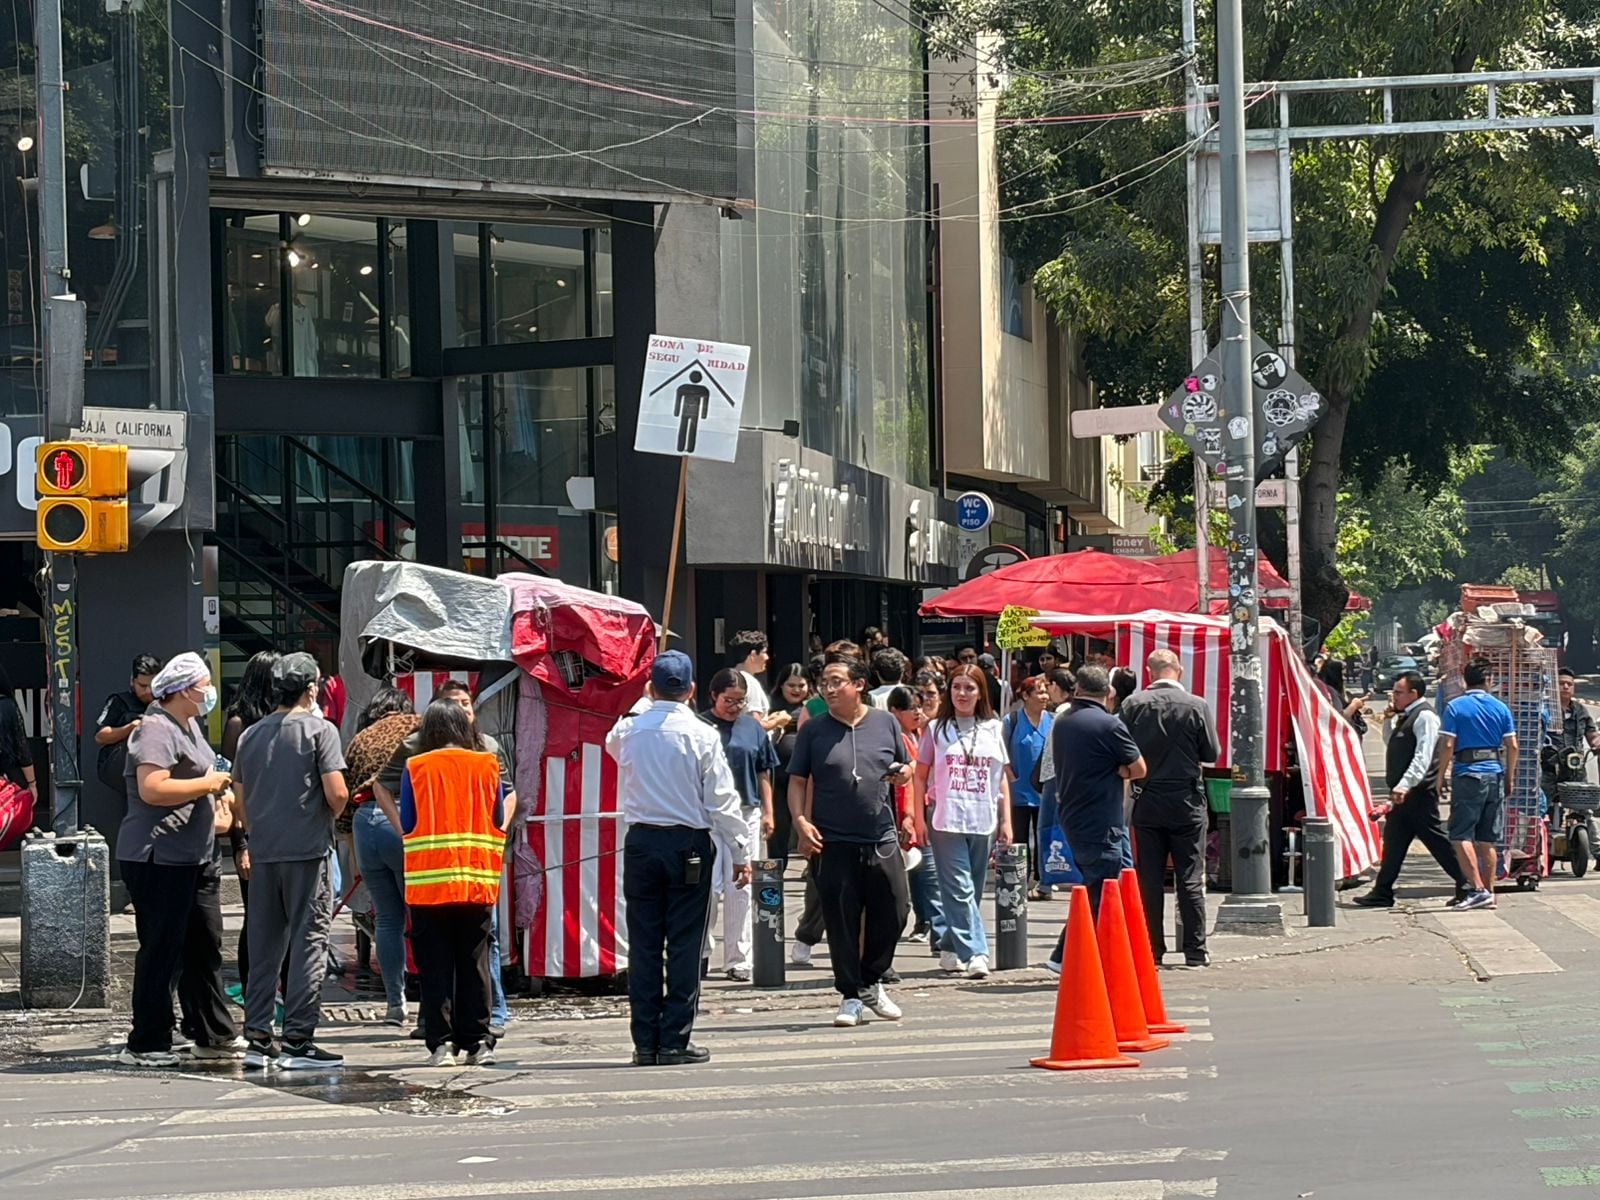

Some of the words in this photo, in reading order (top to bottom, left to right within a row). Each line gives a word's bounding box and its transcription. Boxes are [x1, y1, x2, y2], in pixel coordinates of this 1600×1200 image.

[652, 339, 685, 351] ZONA
[696, 343, 714, 353] DE
[648, 352, 680, 363] SEGU
[707, 359, 745, 371] RIDAD
[79, 420, 106, 434] BAJA
[115, 421, 172, 437] CALIFORNIA
[962, 498, 981, 508] WC
[961, 518, 981, 526] PISO
